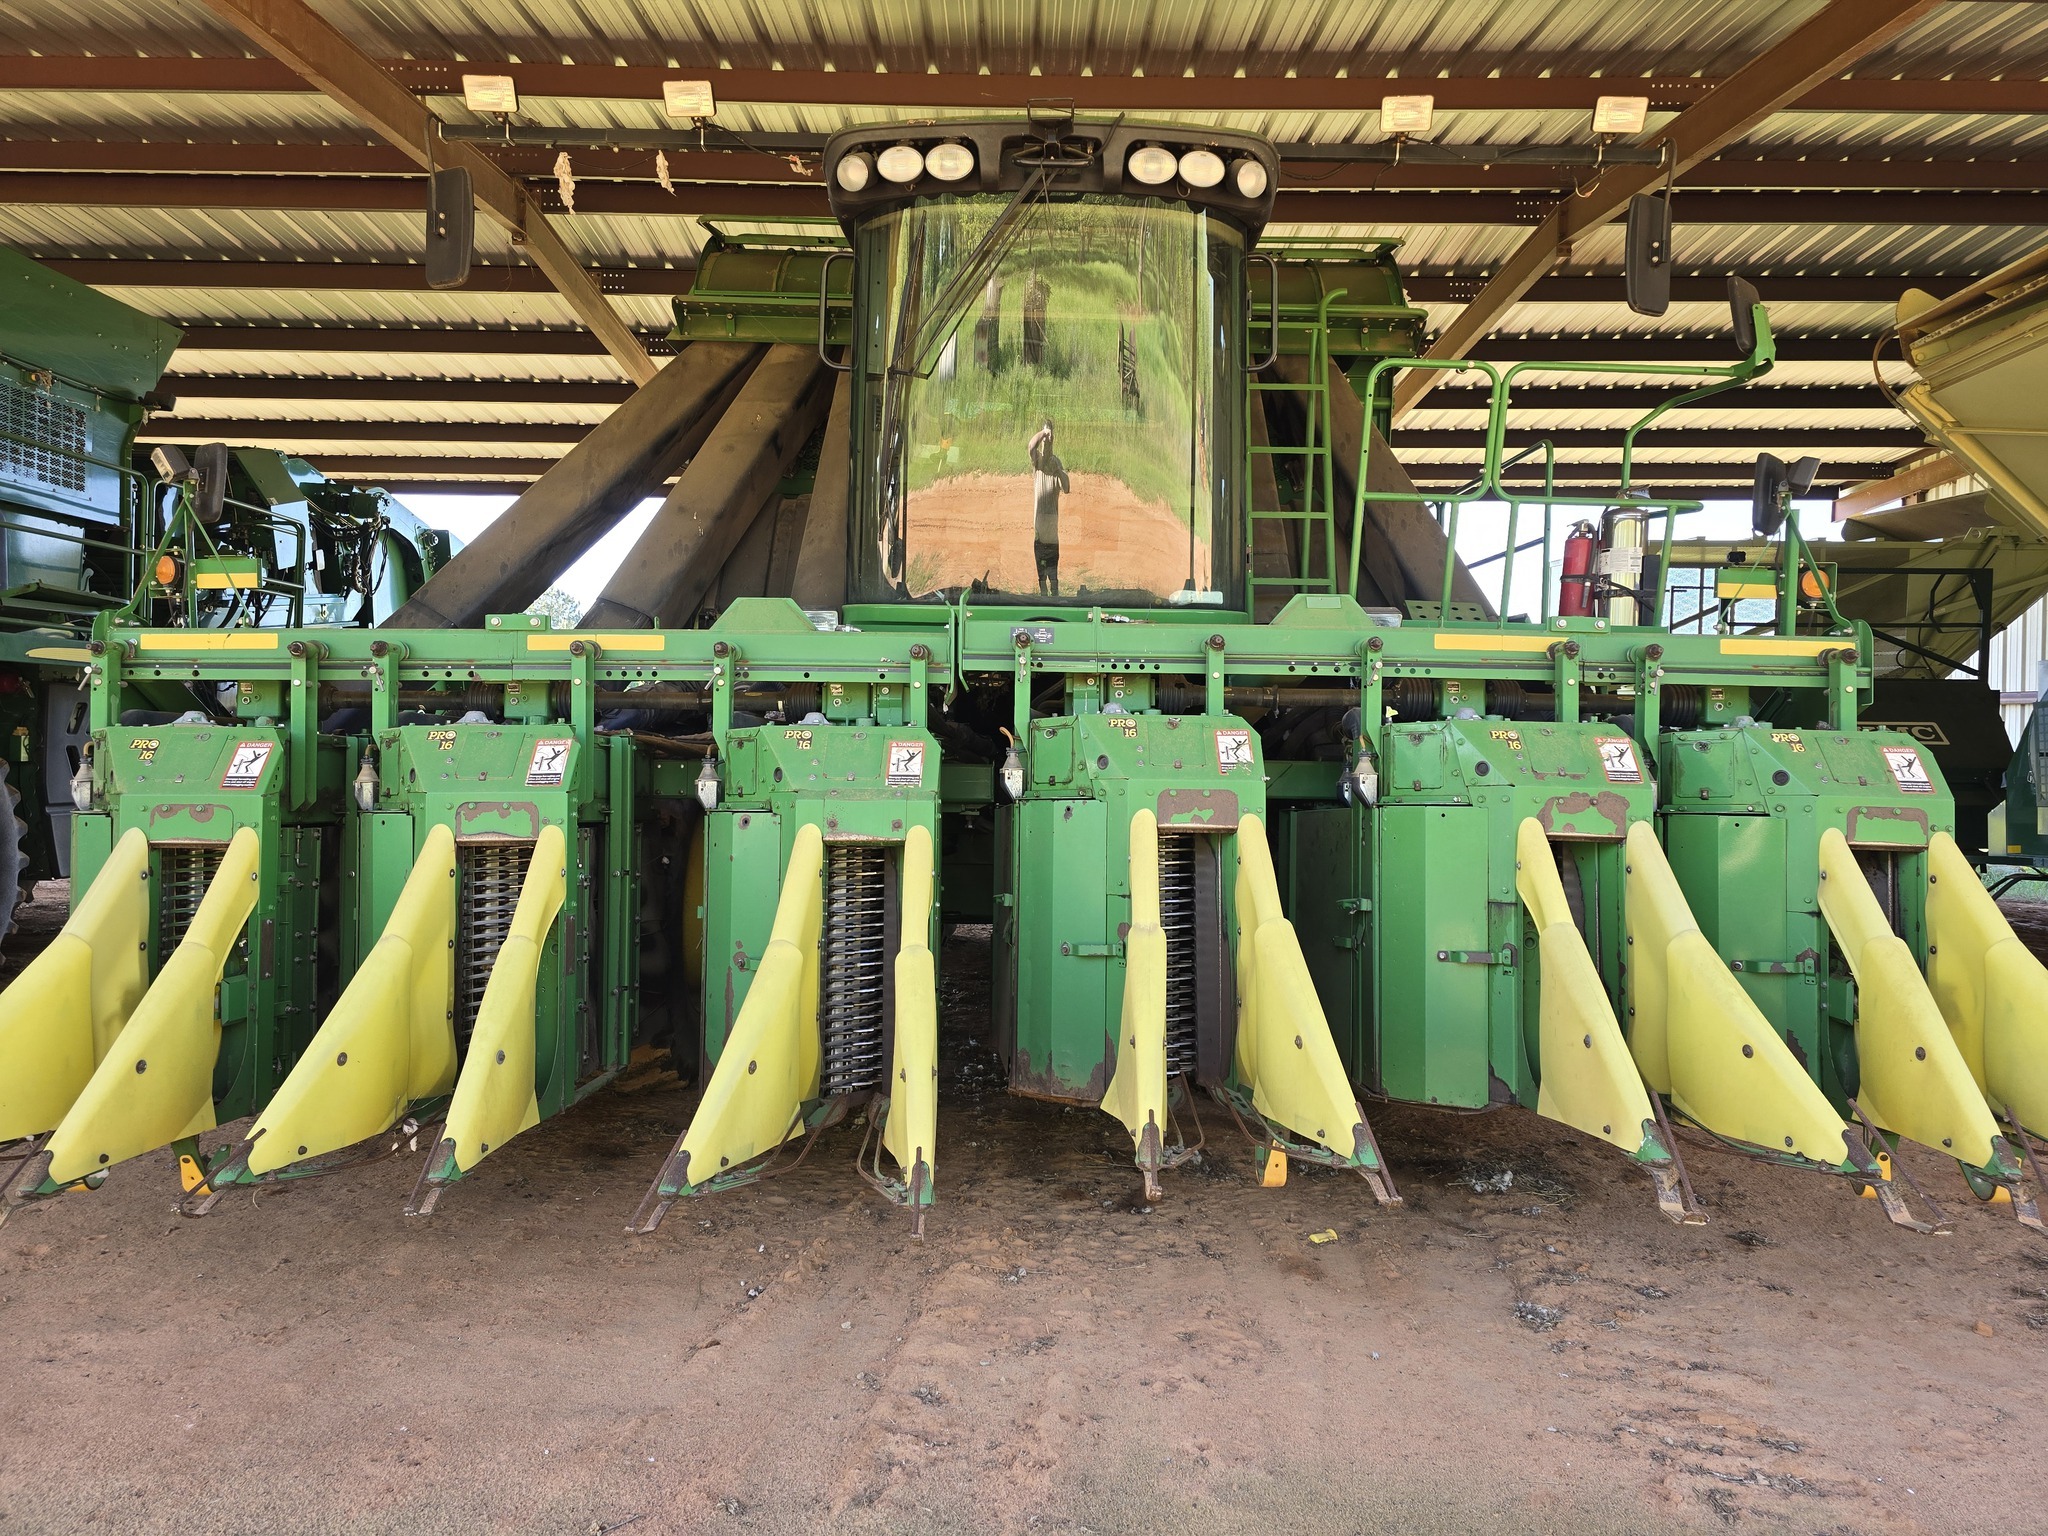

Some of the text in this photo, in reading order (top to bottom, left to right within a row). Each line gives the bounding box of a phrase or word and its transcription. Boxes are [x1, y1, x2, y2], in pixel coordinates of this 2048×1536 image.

[1109, 718, 1136, 728] PRO
[427, 730, 457, 740] PRO
[784, 730, 812, 739] PRO
[1124, 728, 1137, 738] 16
[1491, 730, 1518, 740] PRO
[1771, 732, 1801, 743] PRO
[130, 739, 160, 749] PRO
[440, 740, 454, 750] 16
[798, 740, 811, 750] 16
[1508, 740, 1522, 750] 16
[1791, 743, 1805, 753] 16
[139, 750, 155, 760] 16
